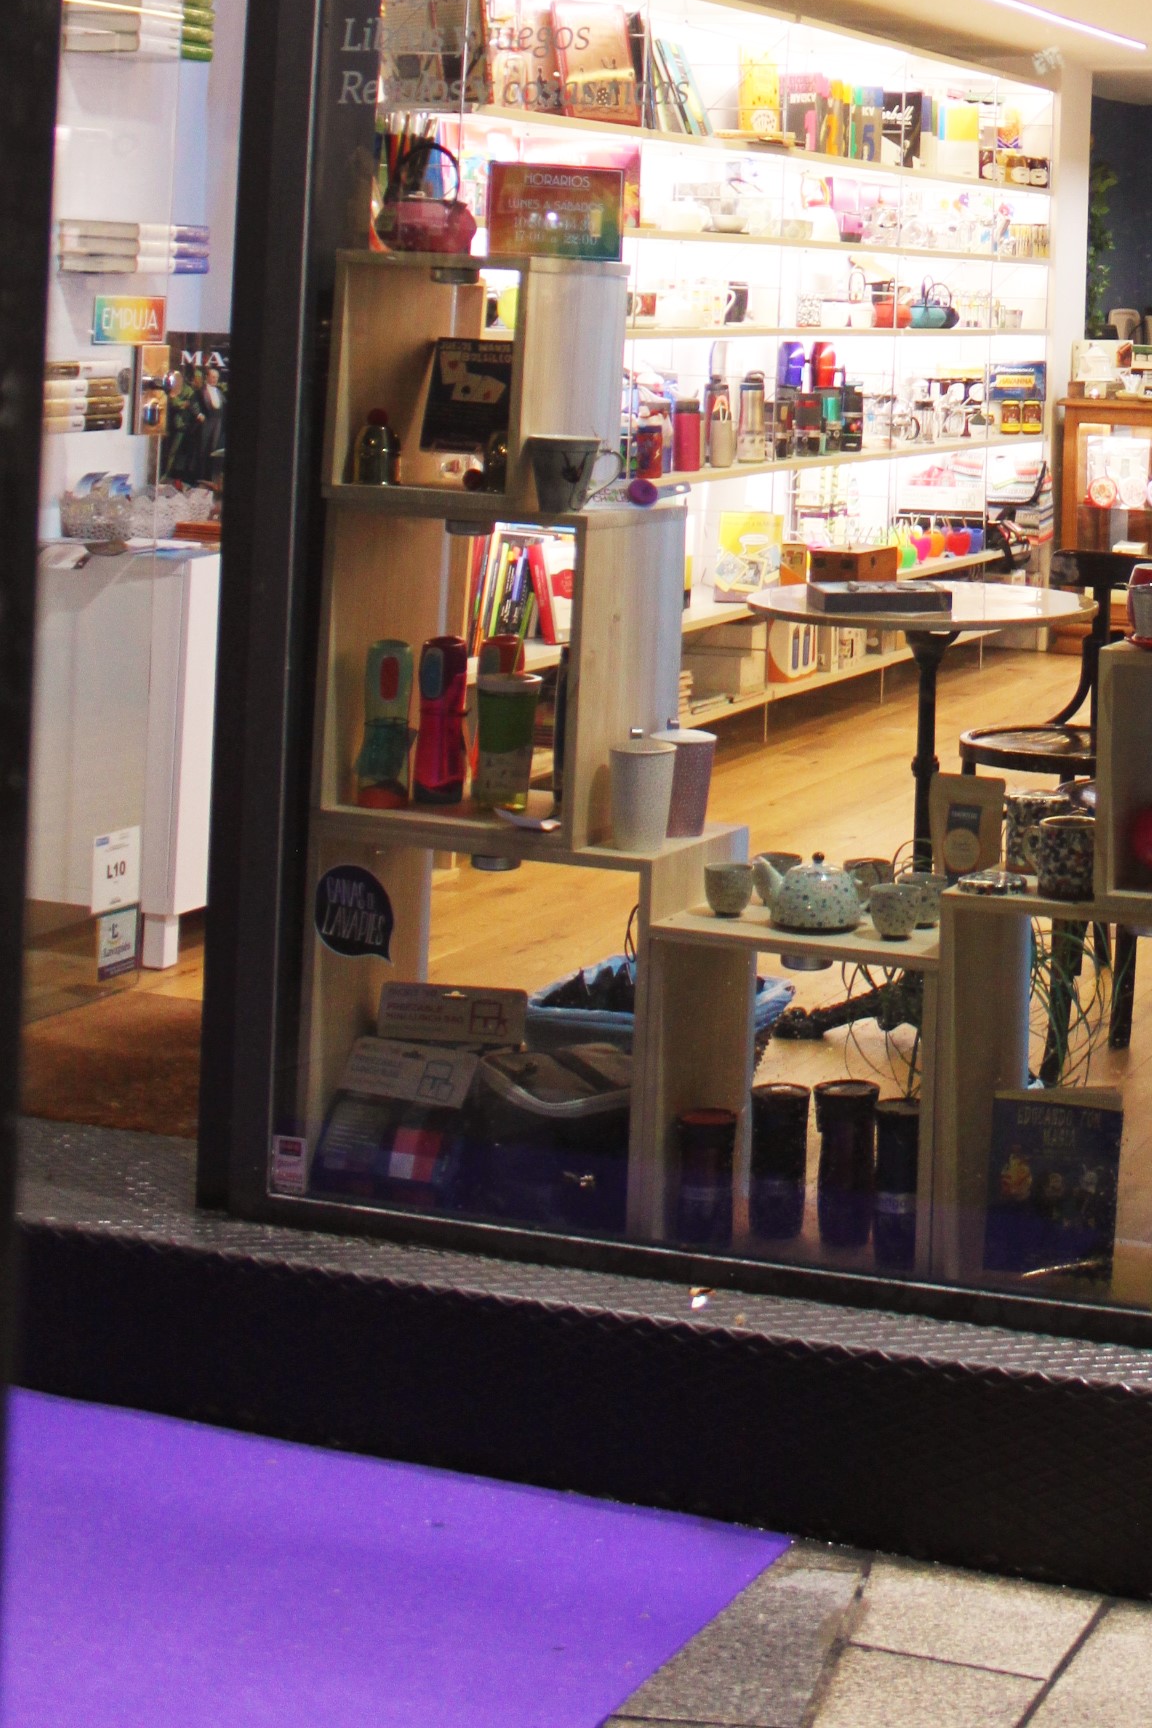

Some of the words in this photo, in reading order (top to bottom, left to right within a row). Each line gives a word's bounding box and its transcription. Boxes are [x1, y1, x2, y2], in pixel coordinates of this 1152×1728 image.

[523, 173, 591, 188] HORARIOS
[508, 198, 540, 210] LUNES
[101, 307, 158, 331] EMPUJA
[106, 860, 126, 879] L10
